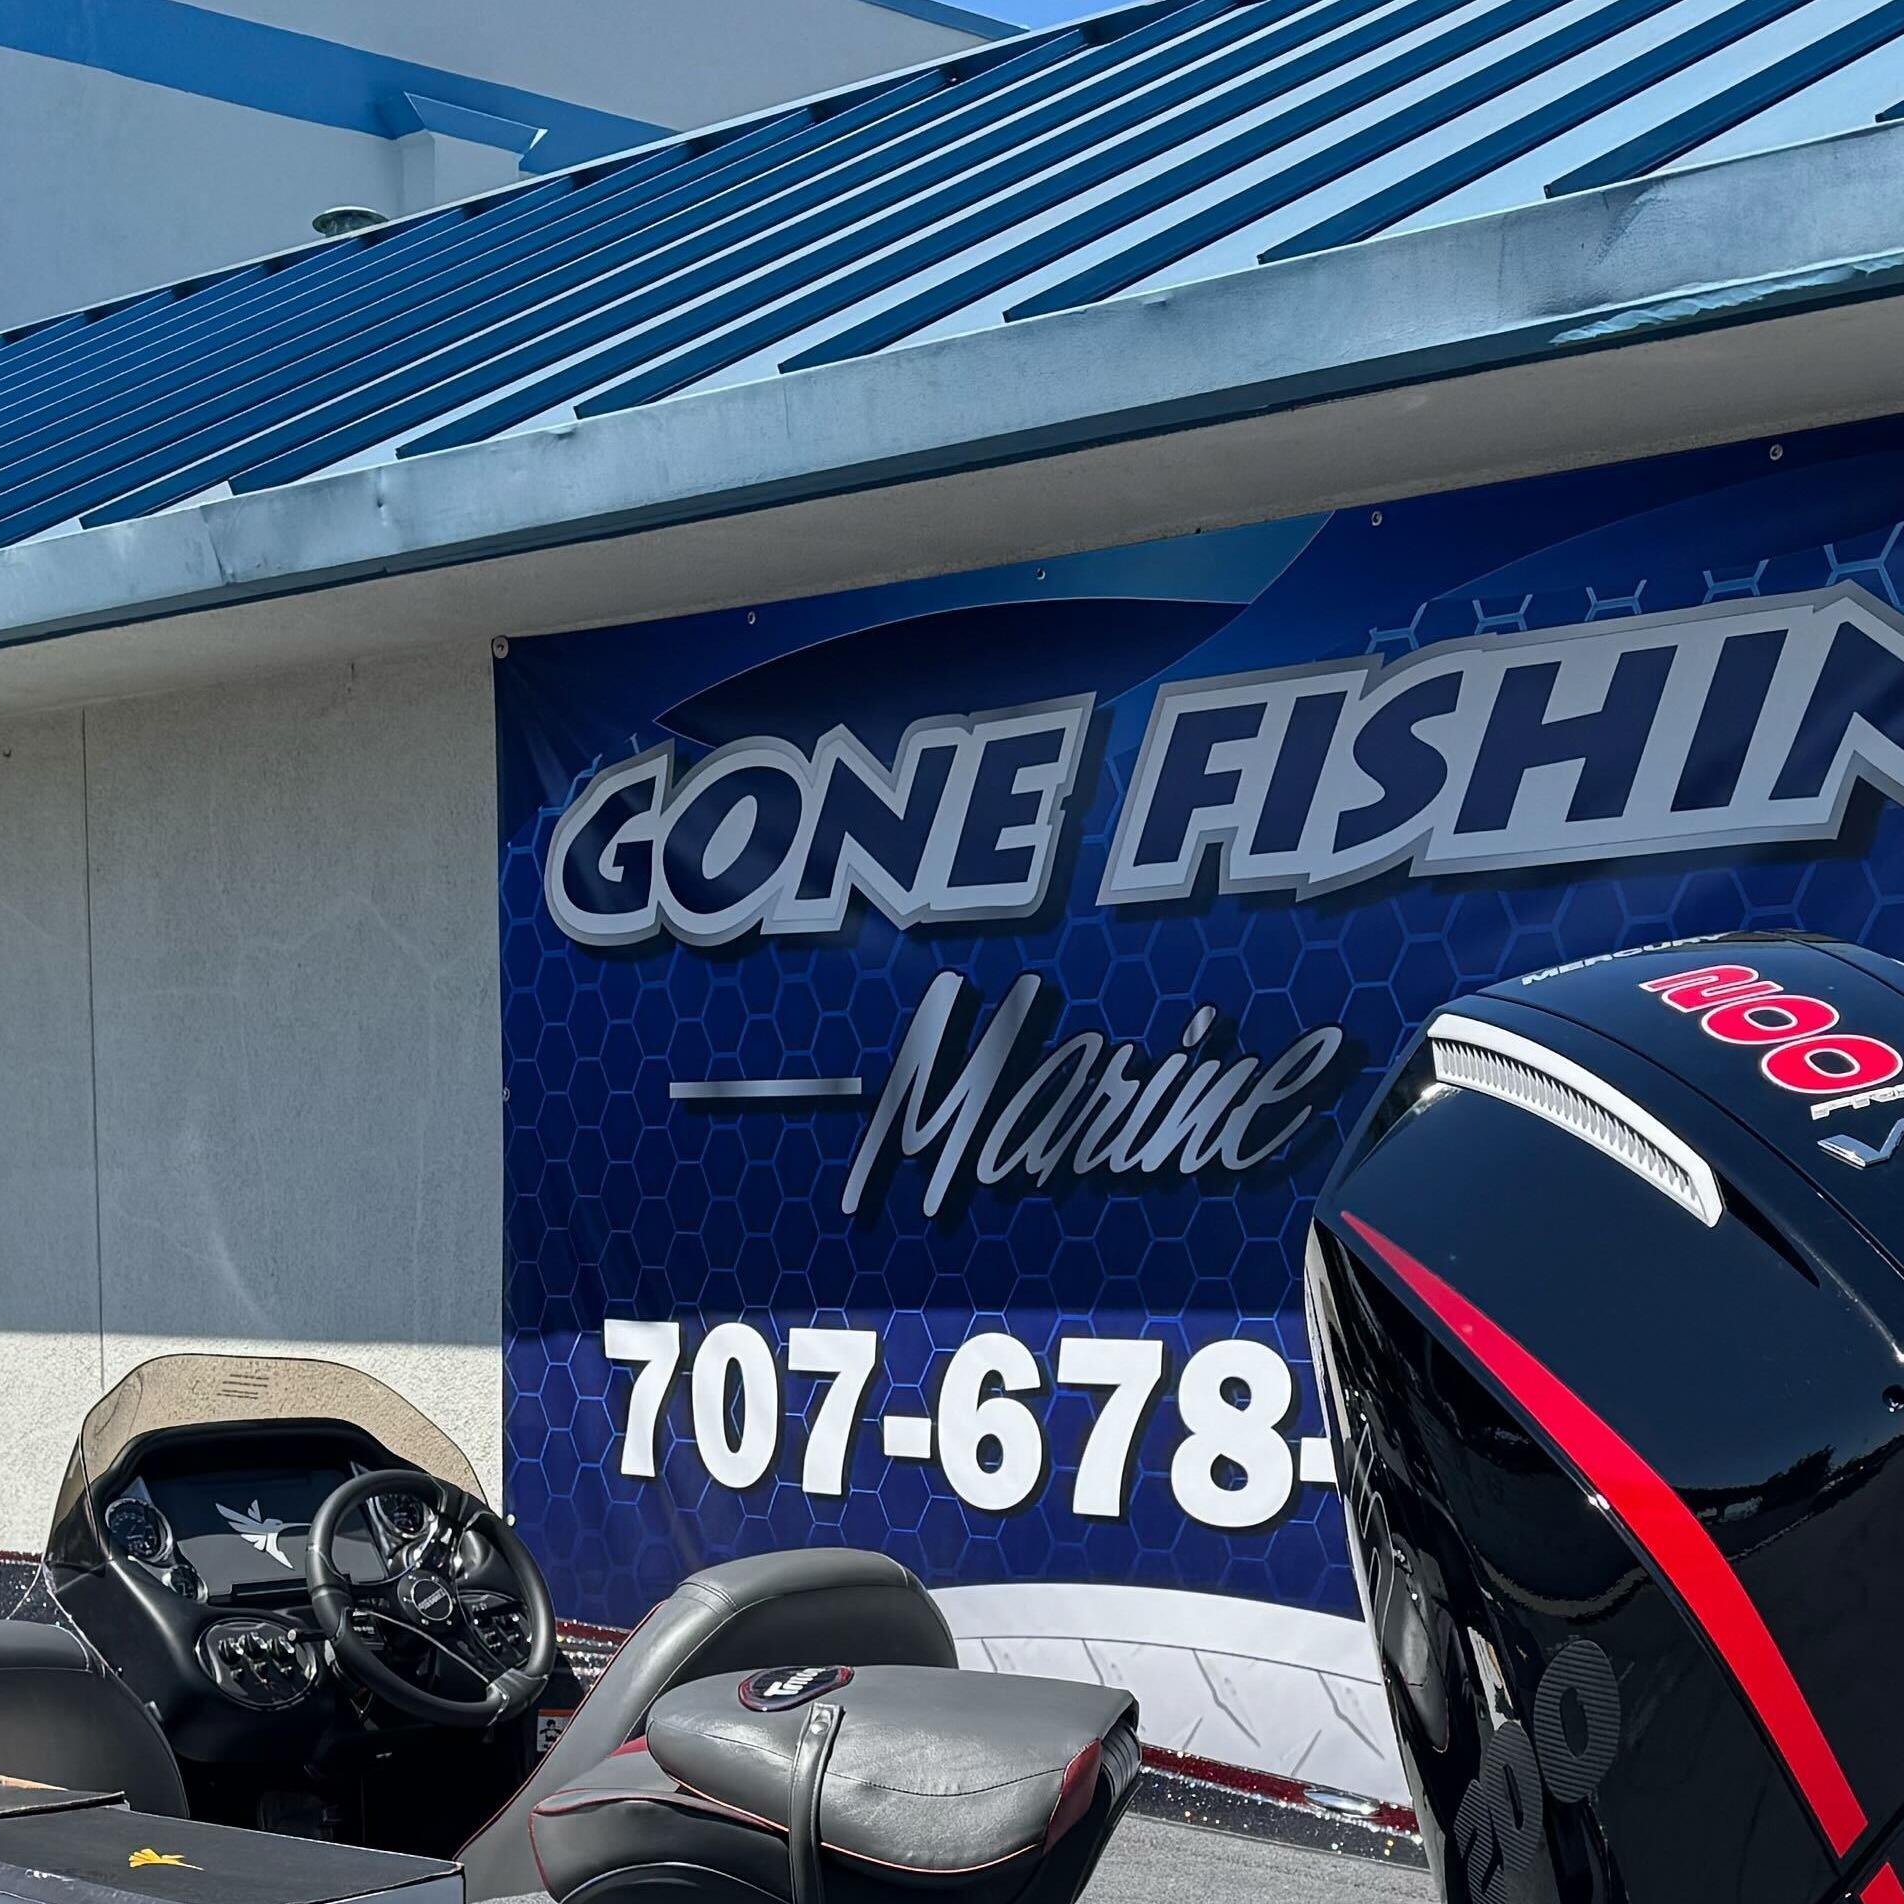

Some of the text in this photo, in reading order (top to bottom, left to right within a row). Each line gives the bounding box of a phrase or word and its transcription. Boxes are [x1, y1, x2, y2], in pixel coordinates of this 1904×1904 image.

[553, 702, 1086, 938] GONE
[841, 970, 1343, 1217] Marine
[1638, 964, 1904, 1094] 200
